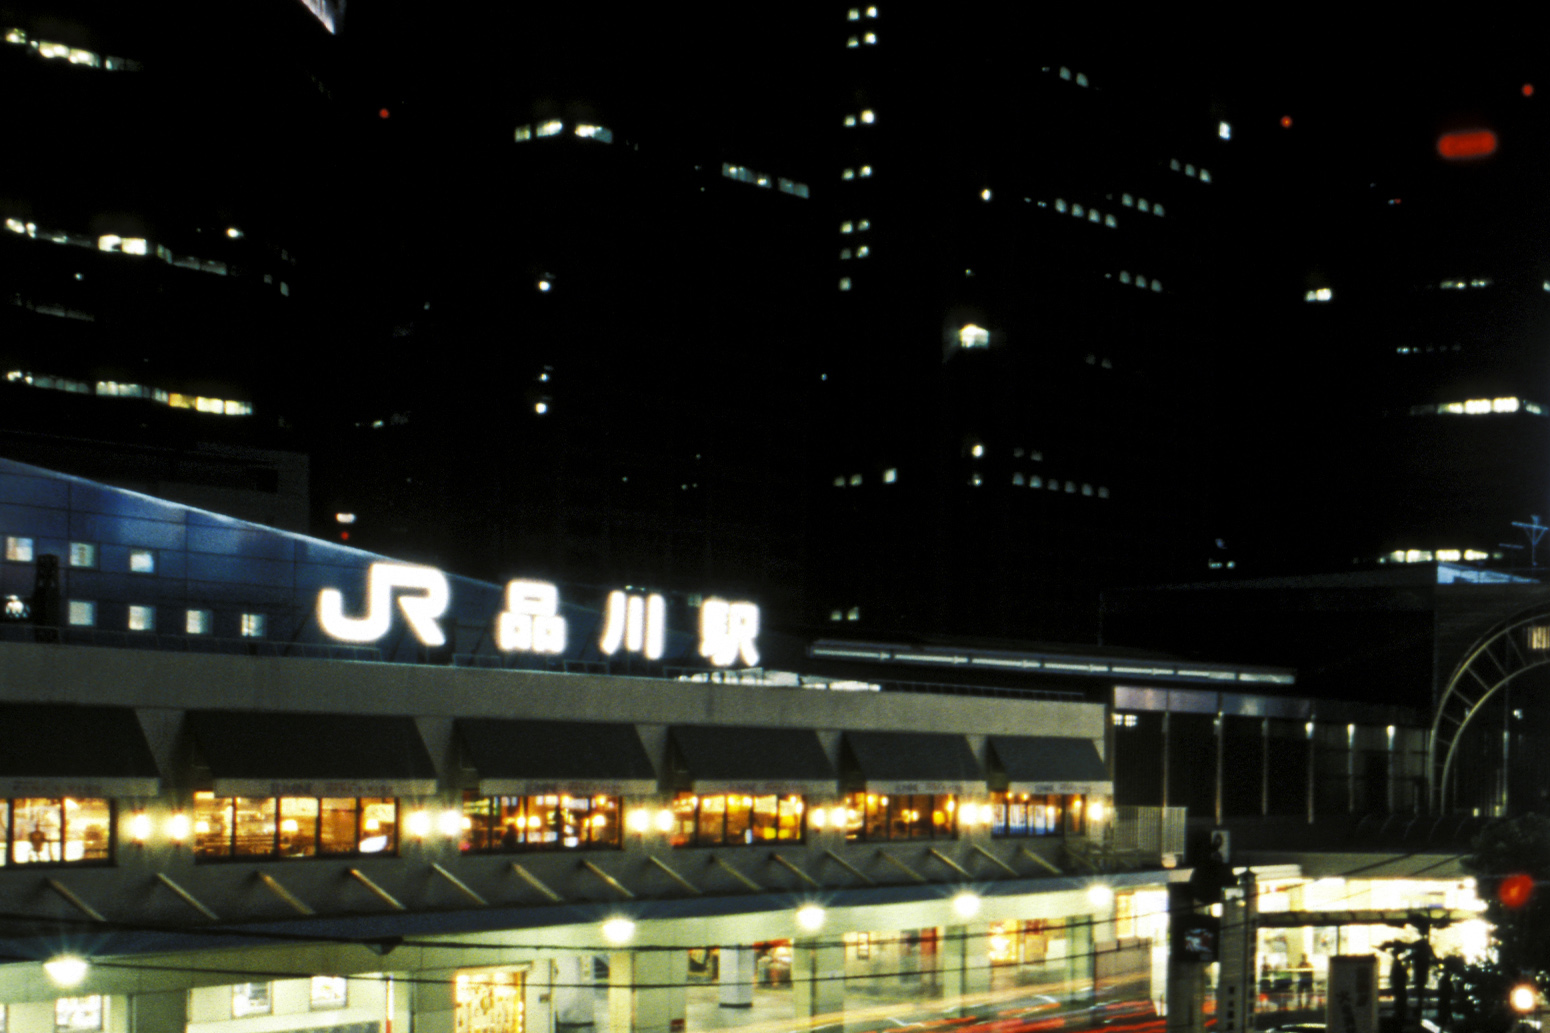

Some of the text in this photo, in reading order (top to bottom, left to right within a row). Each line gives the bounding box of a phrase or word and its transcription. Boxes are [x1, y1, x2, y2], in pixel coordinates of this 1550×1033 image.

[318, 562, 760, 667] JR 品川駅
